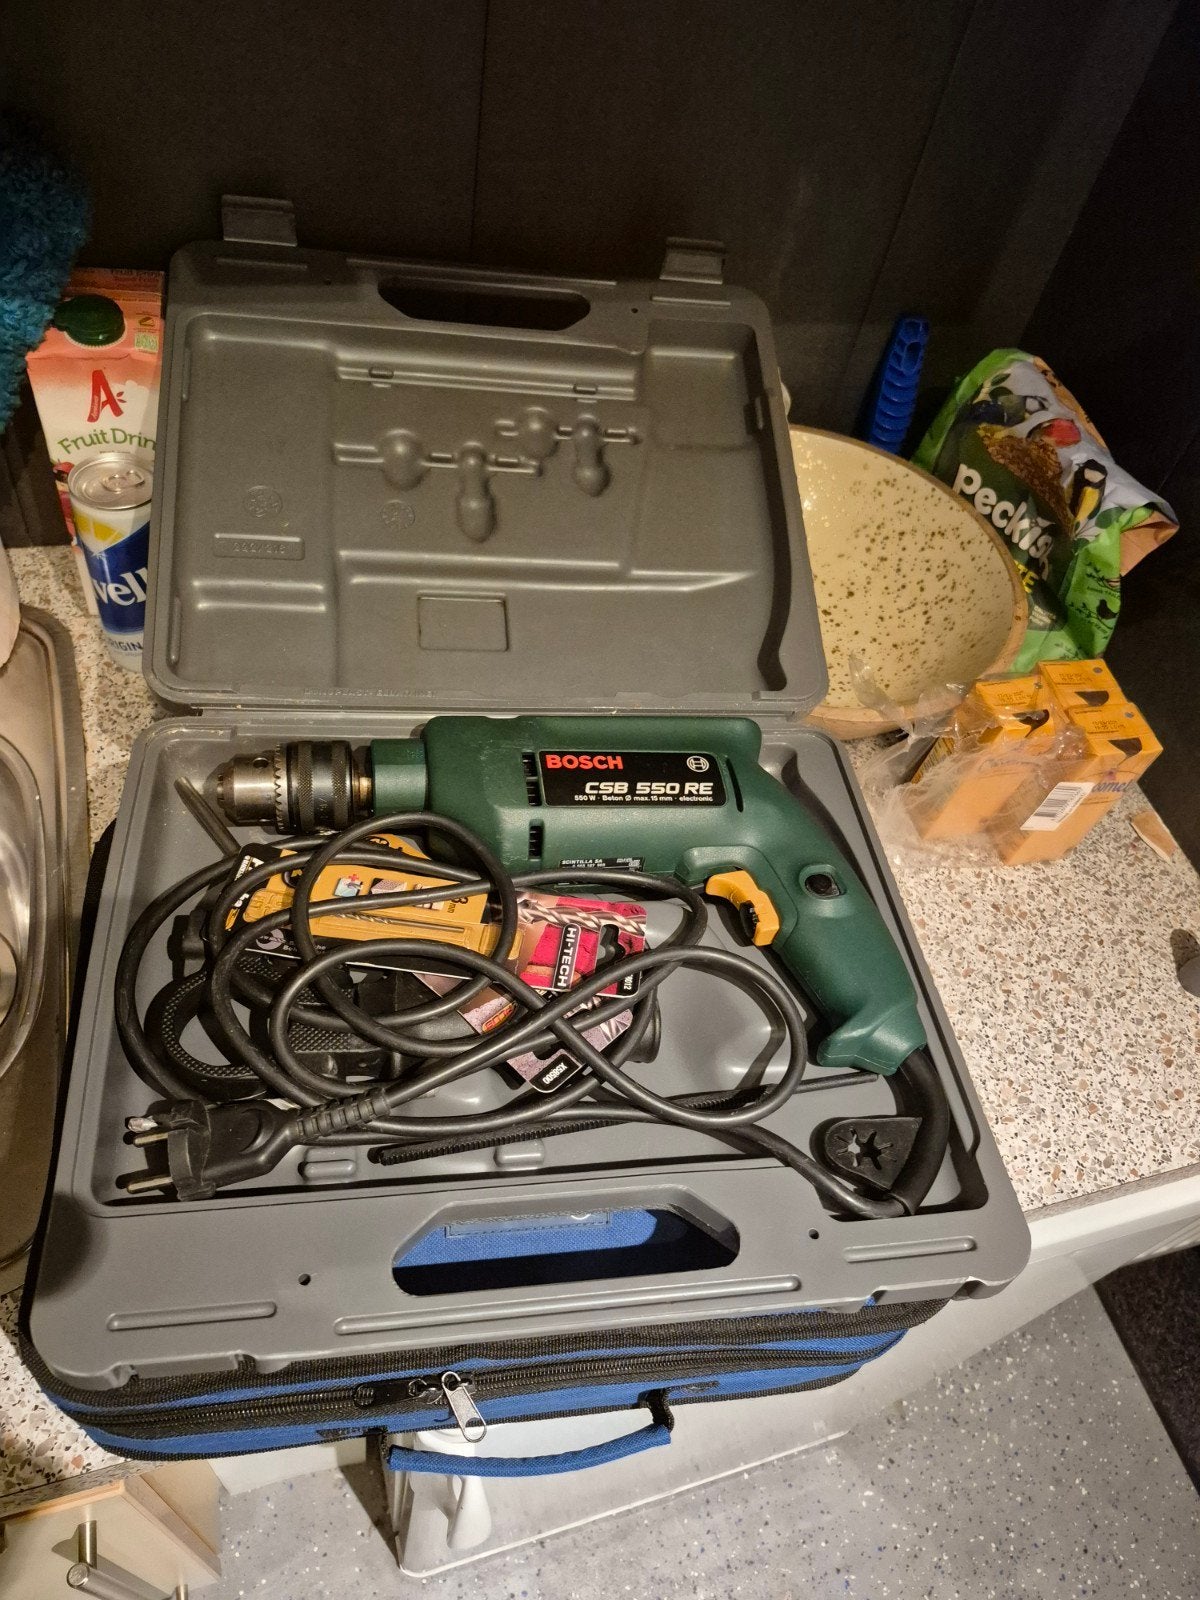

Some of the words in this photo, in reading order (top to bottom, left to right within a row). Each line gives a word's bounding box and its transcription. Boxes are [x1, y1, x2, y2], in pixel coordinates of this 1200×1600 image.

[57, 429, 108, 454] Fruit
[110, 427, 157, 451] Drin
[545, 754, 624, 770] BOSCH
[585, 782, 629, 794] CSB
[635, 782, 681, 795] 550
[684, 782, 714, 795] RE
[557, 927, 577, 987] HI-TECH
